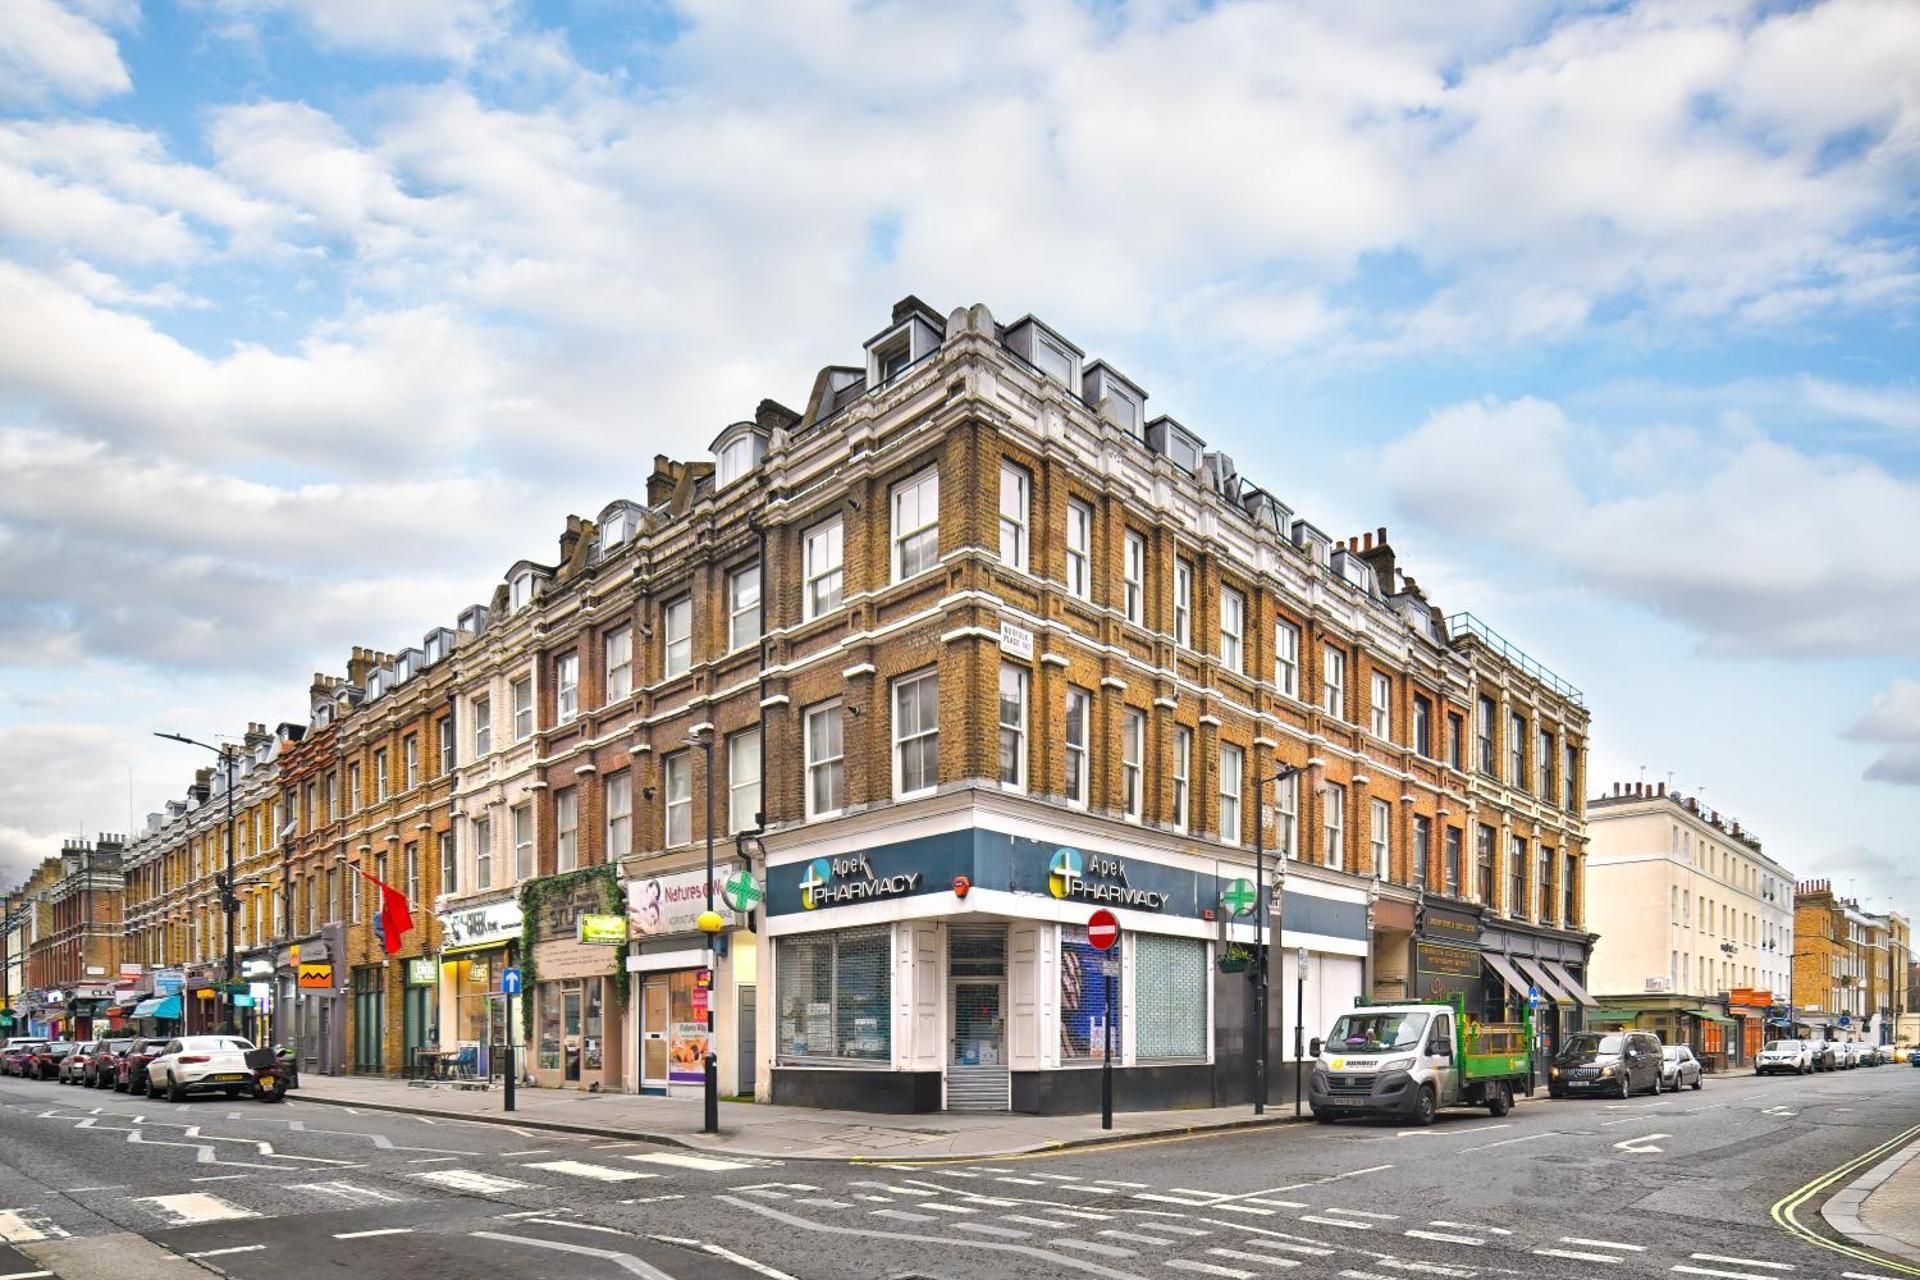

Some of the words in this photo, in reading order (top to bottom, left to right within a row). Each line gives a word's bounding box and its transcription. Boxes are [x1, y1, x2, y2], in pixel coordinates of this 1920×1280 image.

[831, 853, 875, 881] Apek
[1090, 855, 1130, 888] Apek
[665, 885, 702, 904] Natures
[813, 872, 919, 904] PHARMACY
[1071, 880, 1170, 908] PHARMACY
